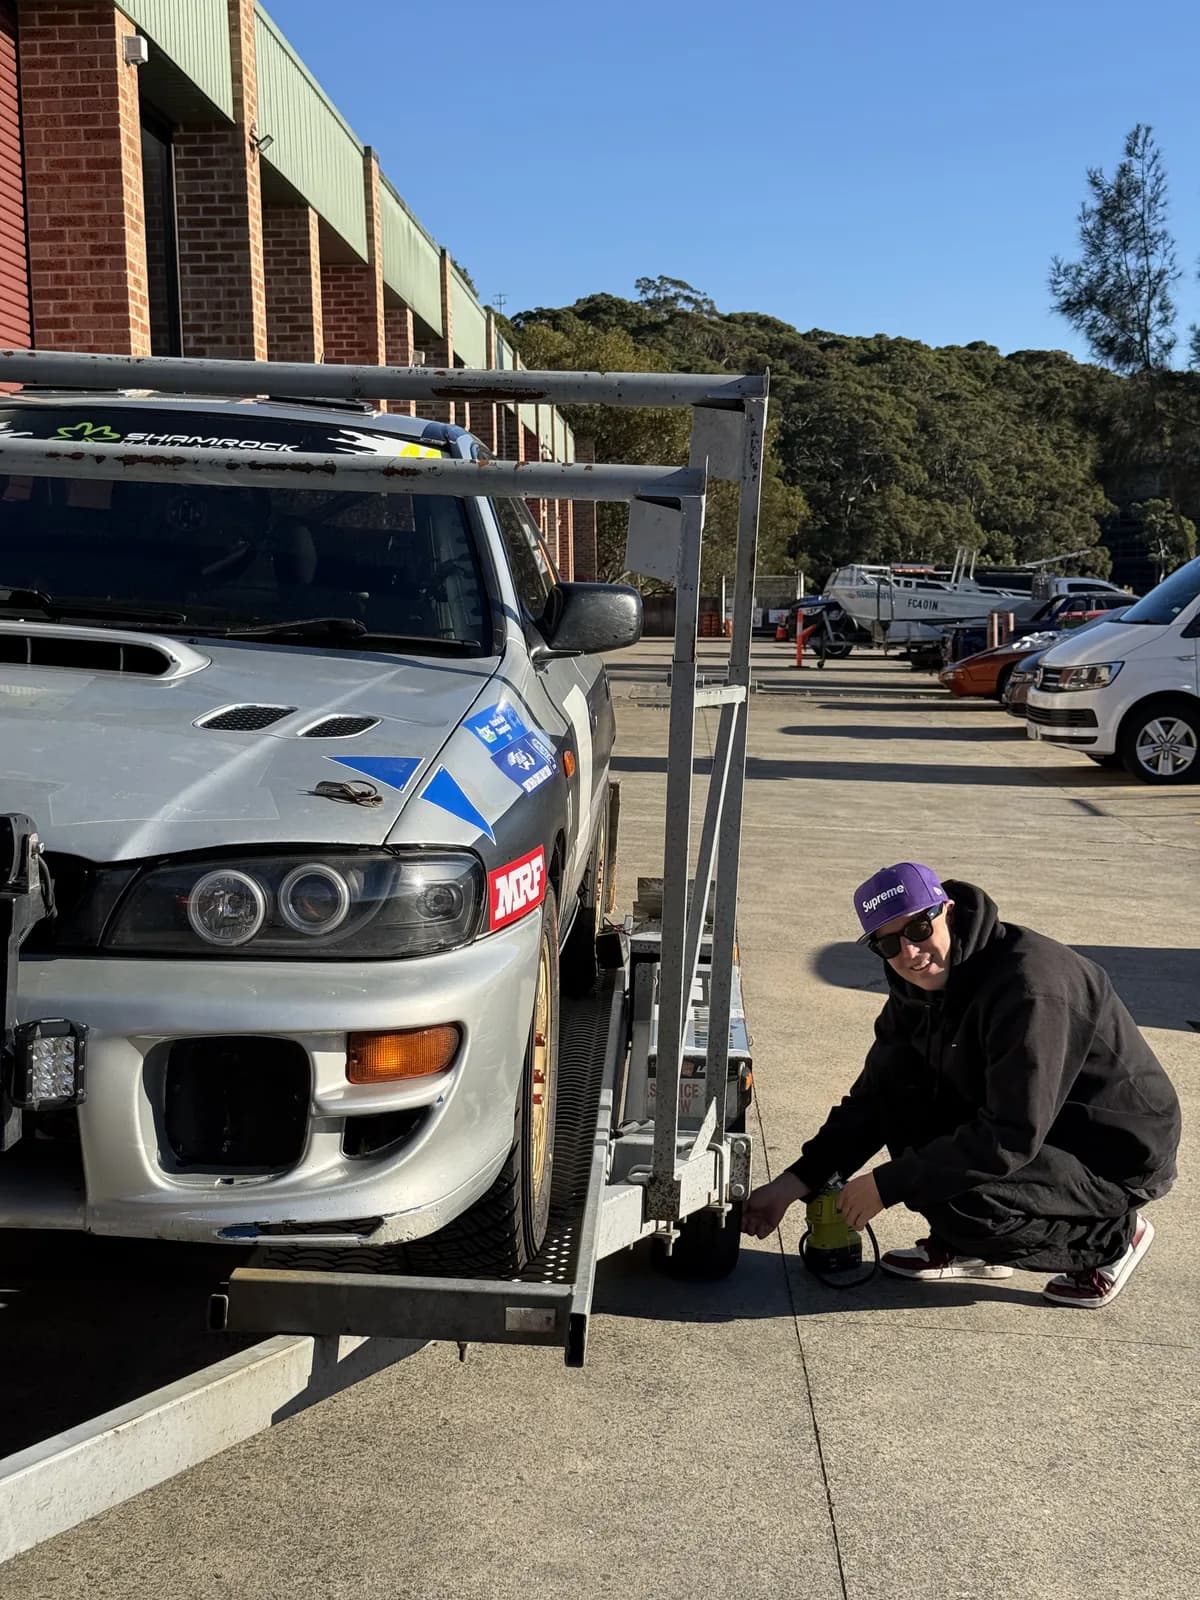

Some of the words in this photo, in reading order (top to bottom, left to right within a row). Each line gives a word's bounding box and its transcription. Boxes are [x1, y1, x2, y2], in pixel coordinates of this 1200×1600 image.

[125, 433, 300, 452] SHAMROCK
[495, 854, 544, 921] MRF
[862, 884, 905, 913] Supreme
